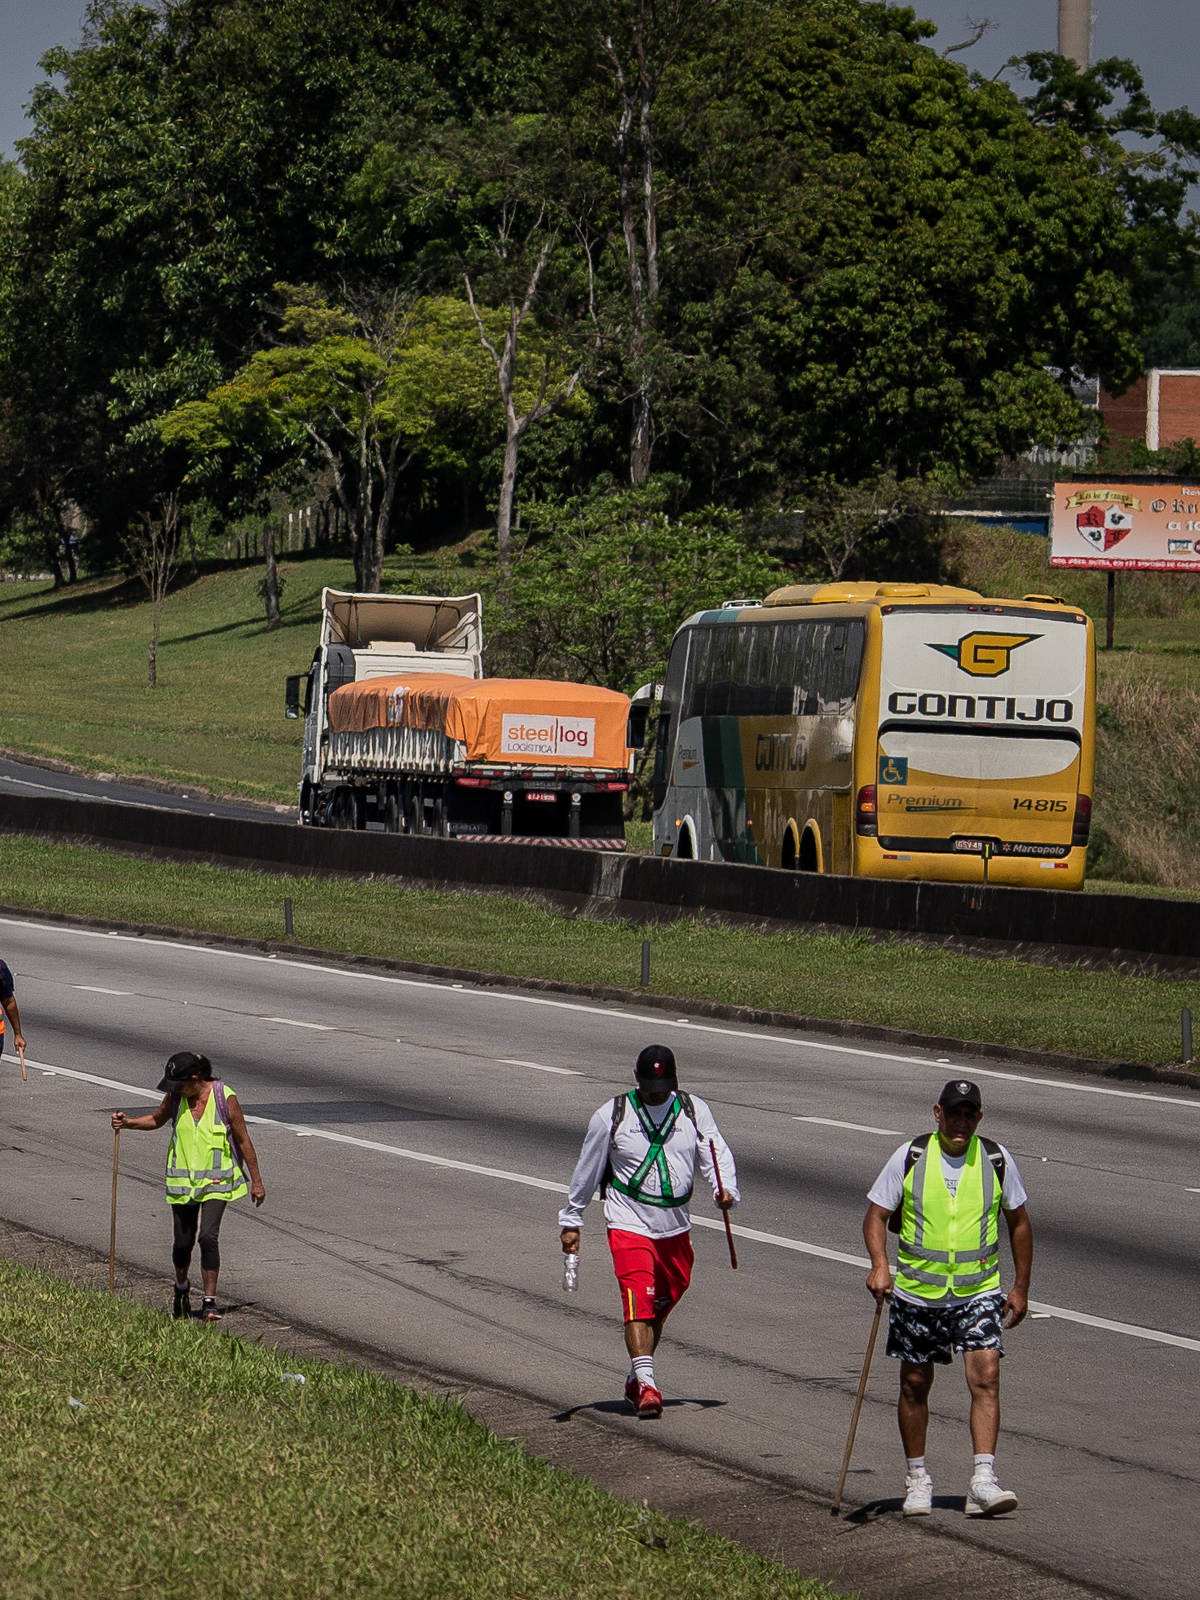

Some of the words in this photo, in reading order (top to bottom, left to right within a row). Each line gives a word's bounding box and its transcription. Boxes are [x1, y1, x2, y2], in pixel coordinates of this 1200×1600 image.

[888, 691, 1073, 723] GONTIJO
[508, 724, 554, 742] steel
[559, 726, 588, 747] log
[507, 742, 553, 754] LOGÍSTICA
[887, 793, 963, 807] Premium
[1012, 798, 1068, 813] 14815
[1012, 844, 1065, 855] Marcopolo
